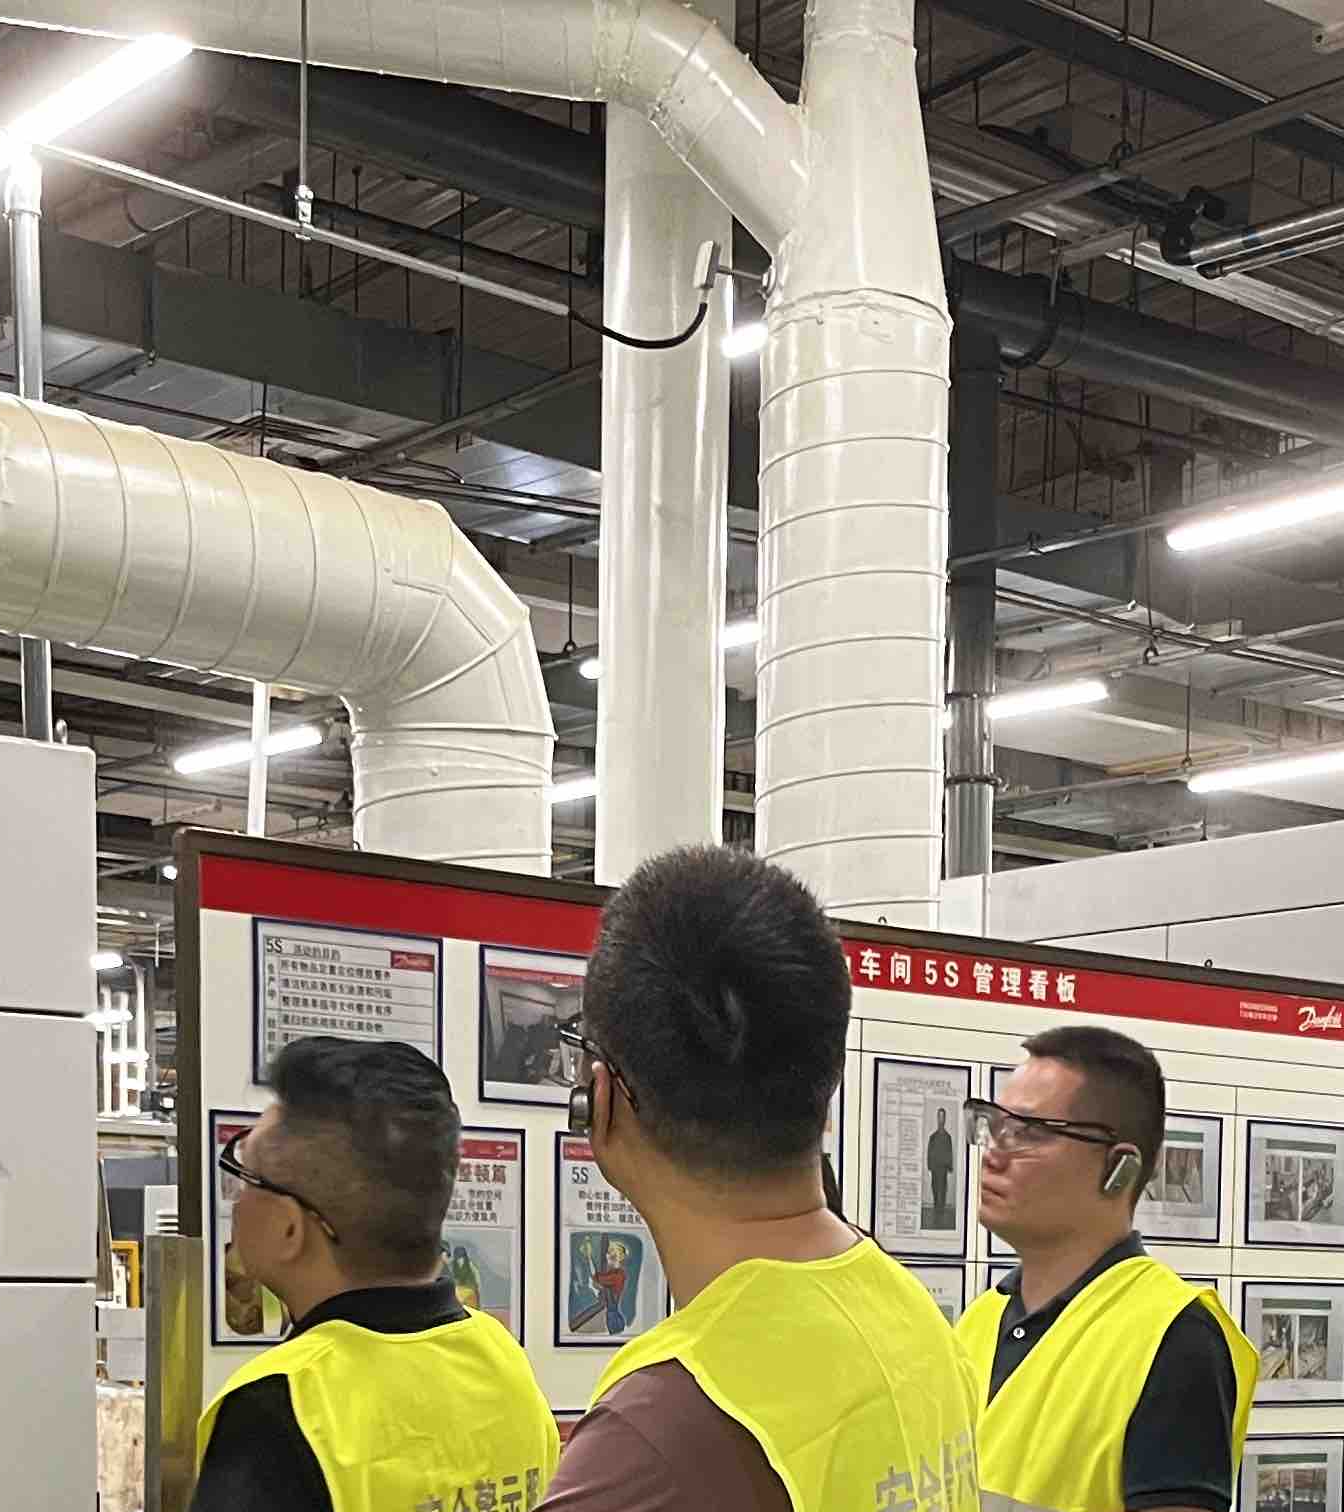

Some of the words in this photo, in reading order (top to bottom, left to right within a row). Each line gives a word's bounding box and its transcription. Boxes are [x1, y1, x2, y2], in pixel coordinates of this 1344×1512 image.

[265, 937, 283, 954] 5S
[845, 948, 912, 985] 车间
[571, 1166, 589, 1184] 5S
